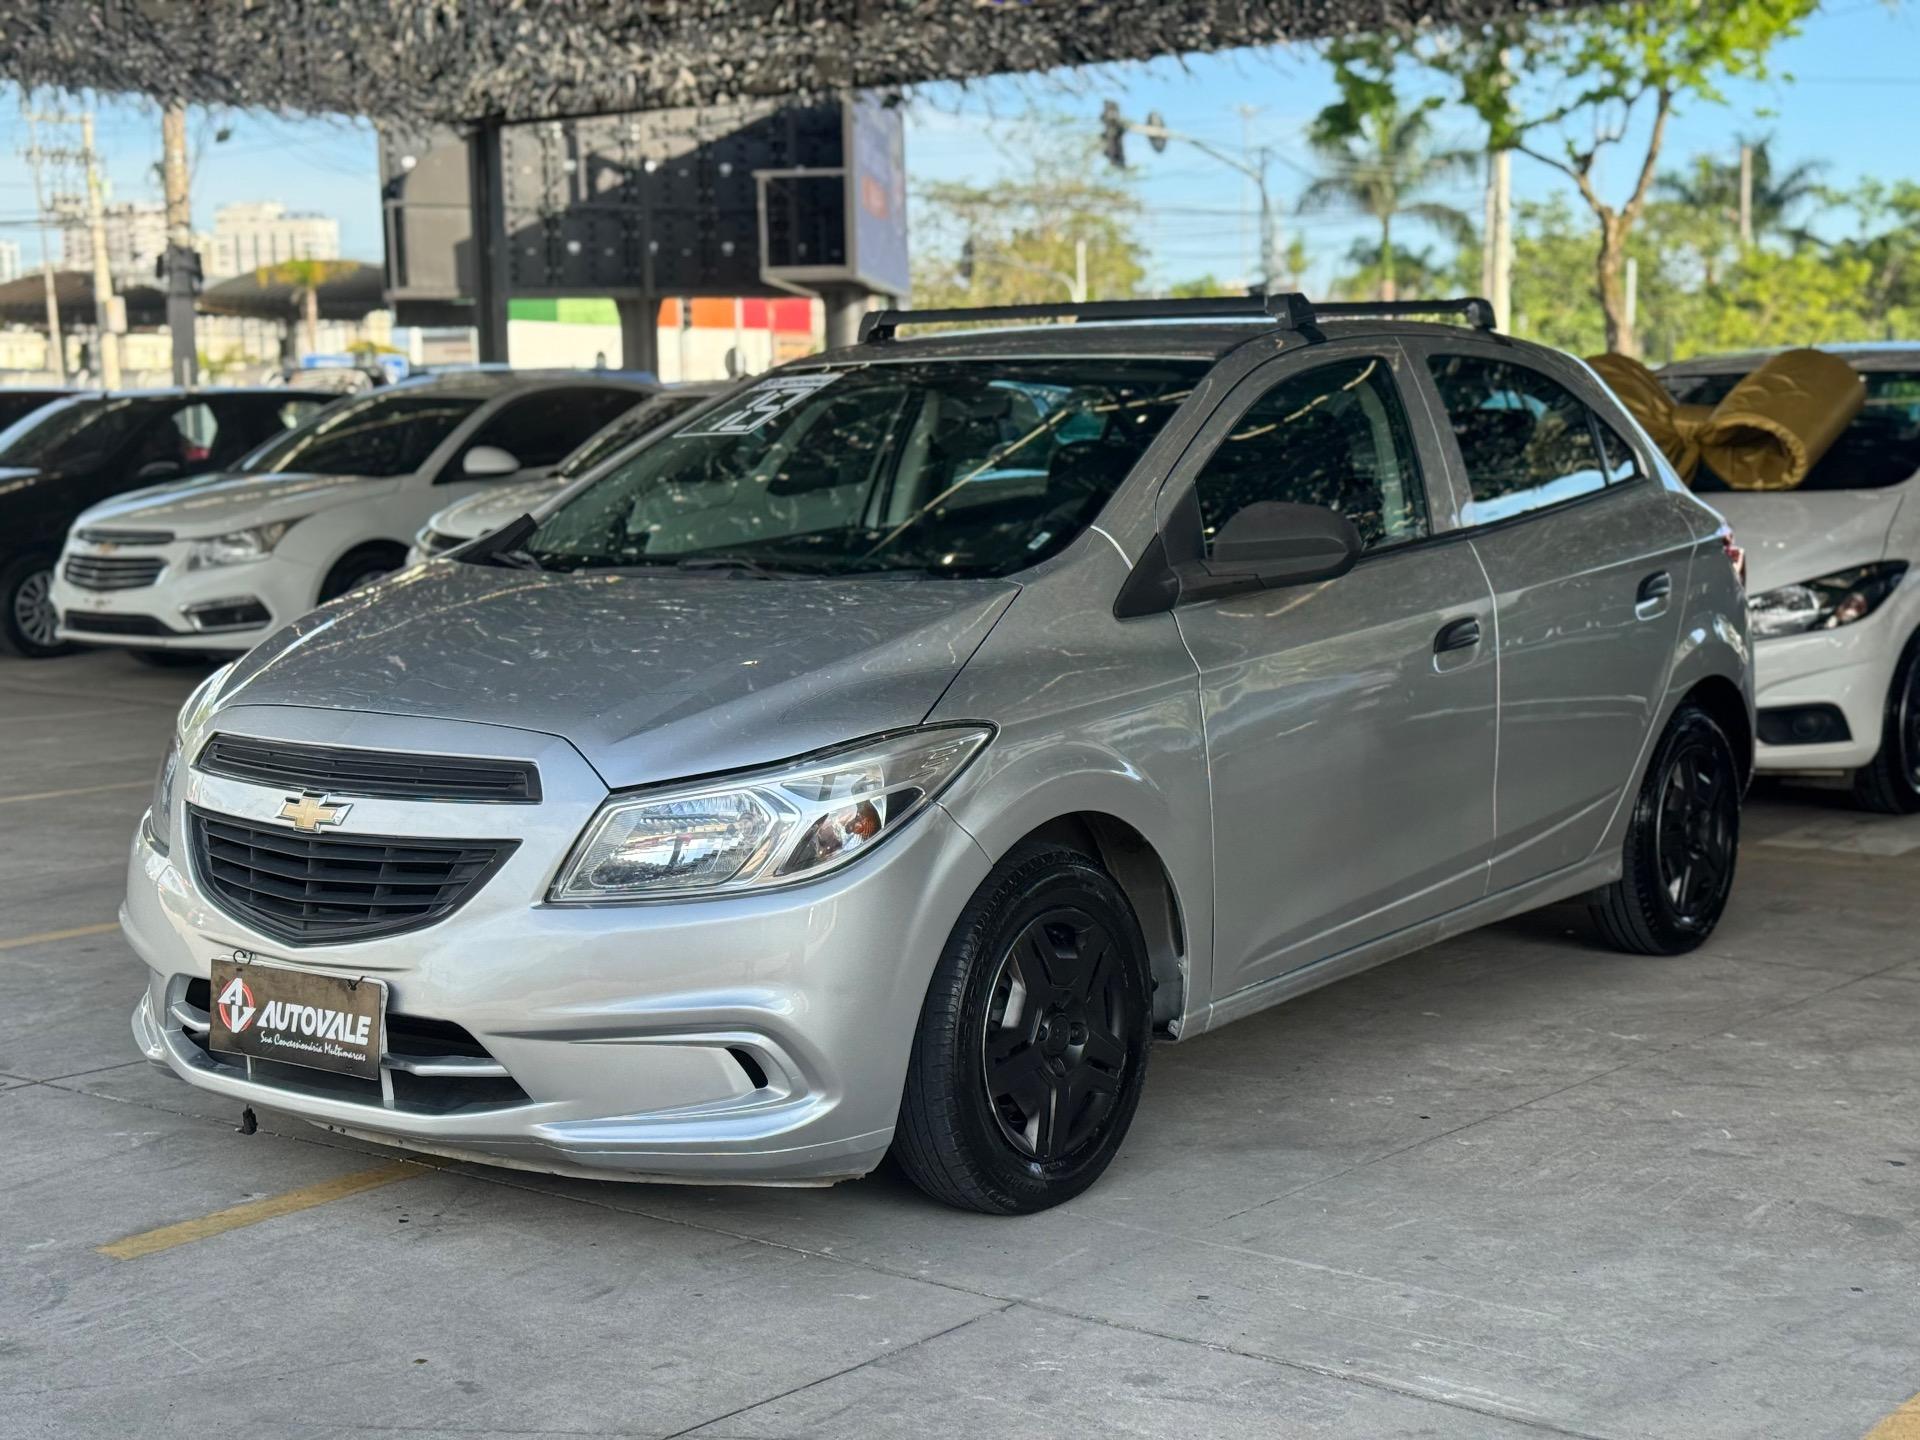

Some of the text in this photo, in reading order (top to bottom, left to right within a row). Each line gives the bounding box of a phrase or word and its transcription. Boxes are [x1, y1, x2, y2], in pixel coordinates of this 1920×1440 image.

[256, 1001, 372, 1046] AUTOVALE
[260, 1030, 273, 1043] Sua
[324, 1042, 367, 1062] Multimarcas
